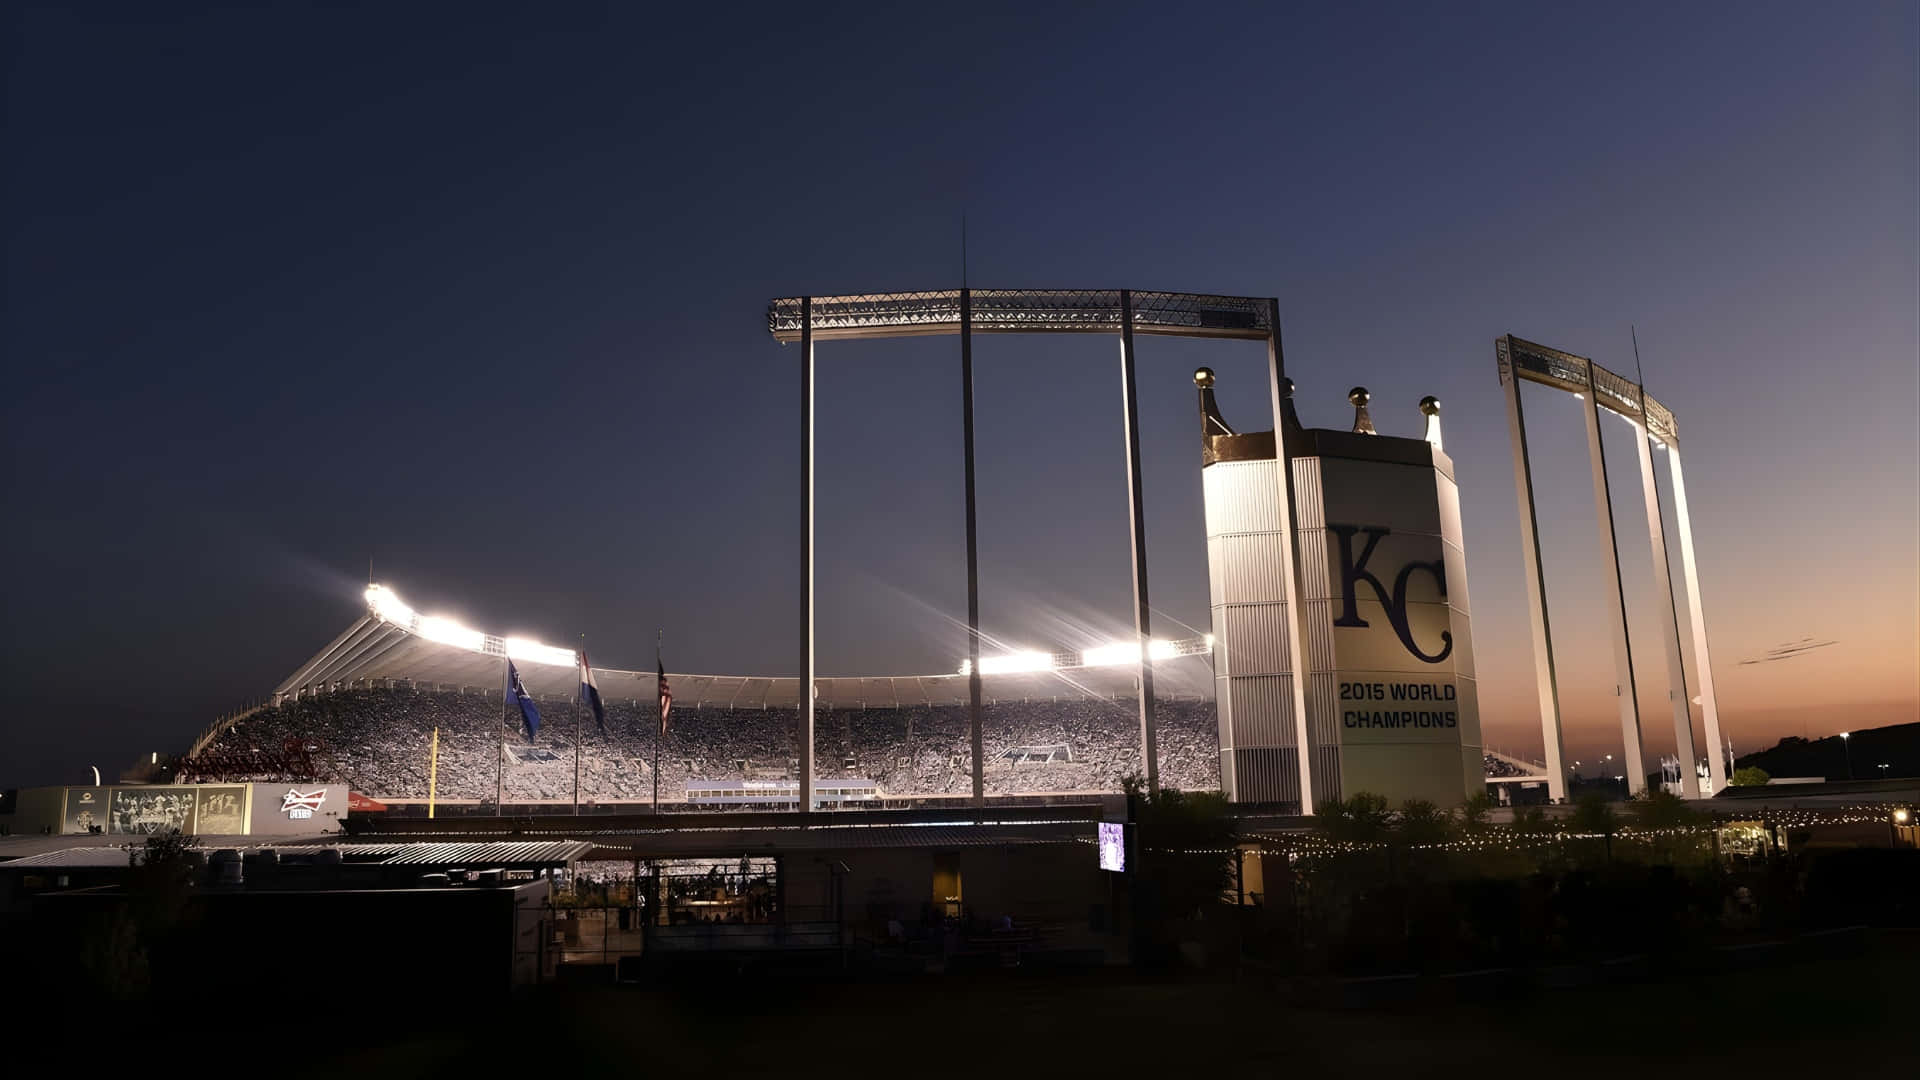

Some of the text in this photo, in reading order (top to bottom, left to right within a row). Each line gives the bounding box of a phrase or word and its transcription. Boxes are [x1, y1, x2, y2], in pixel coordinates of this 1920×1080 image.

[1327, 523, 1453, 663] KC
[1340, 682, 1456, 701] 2015 WORLD
[1344, 711, 1457, 729] CHAMPIONS
